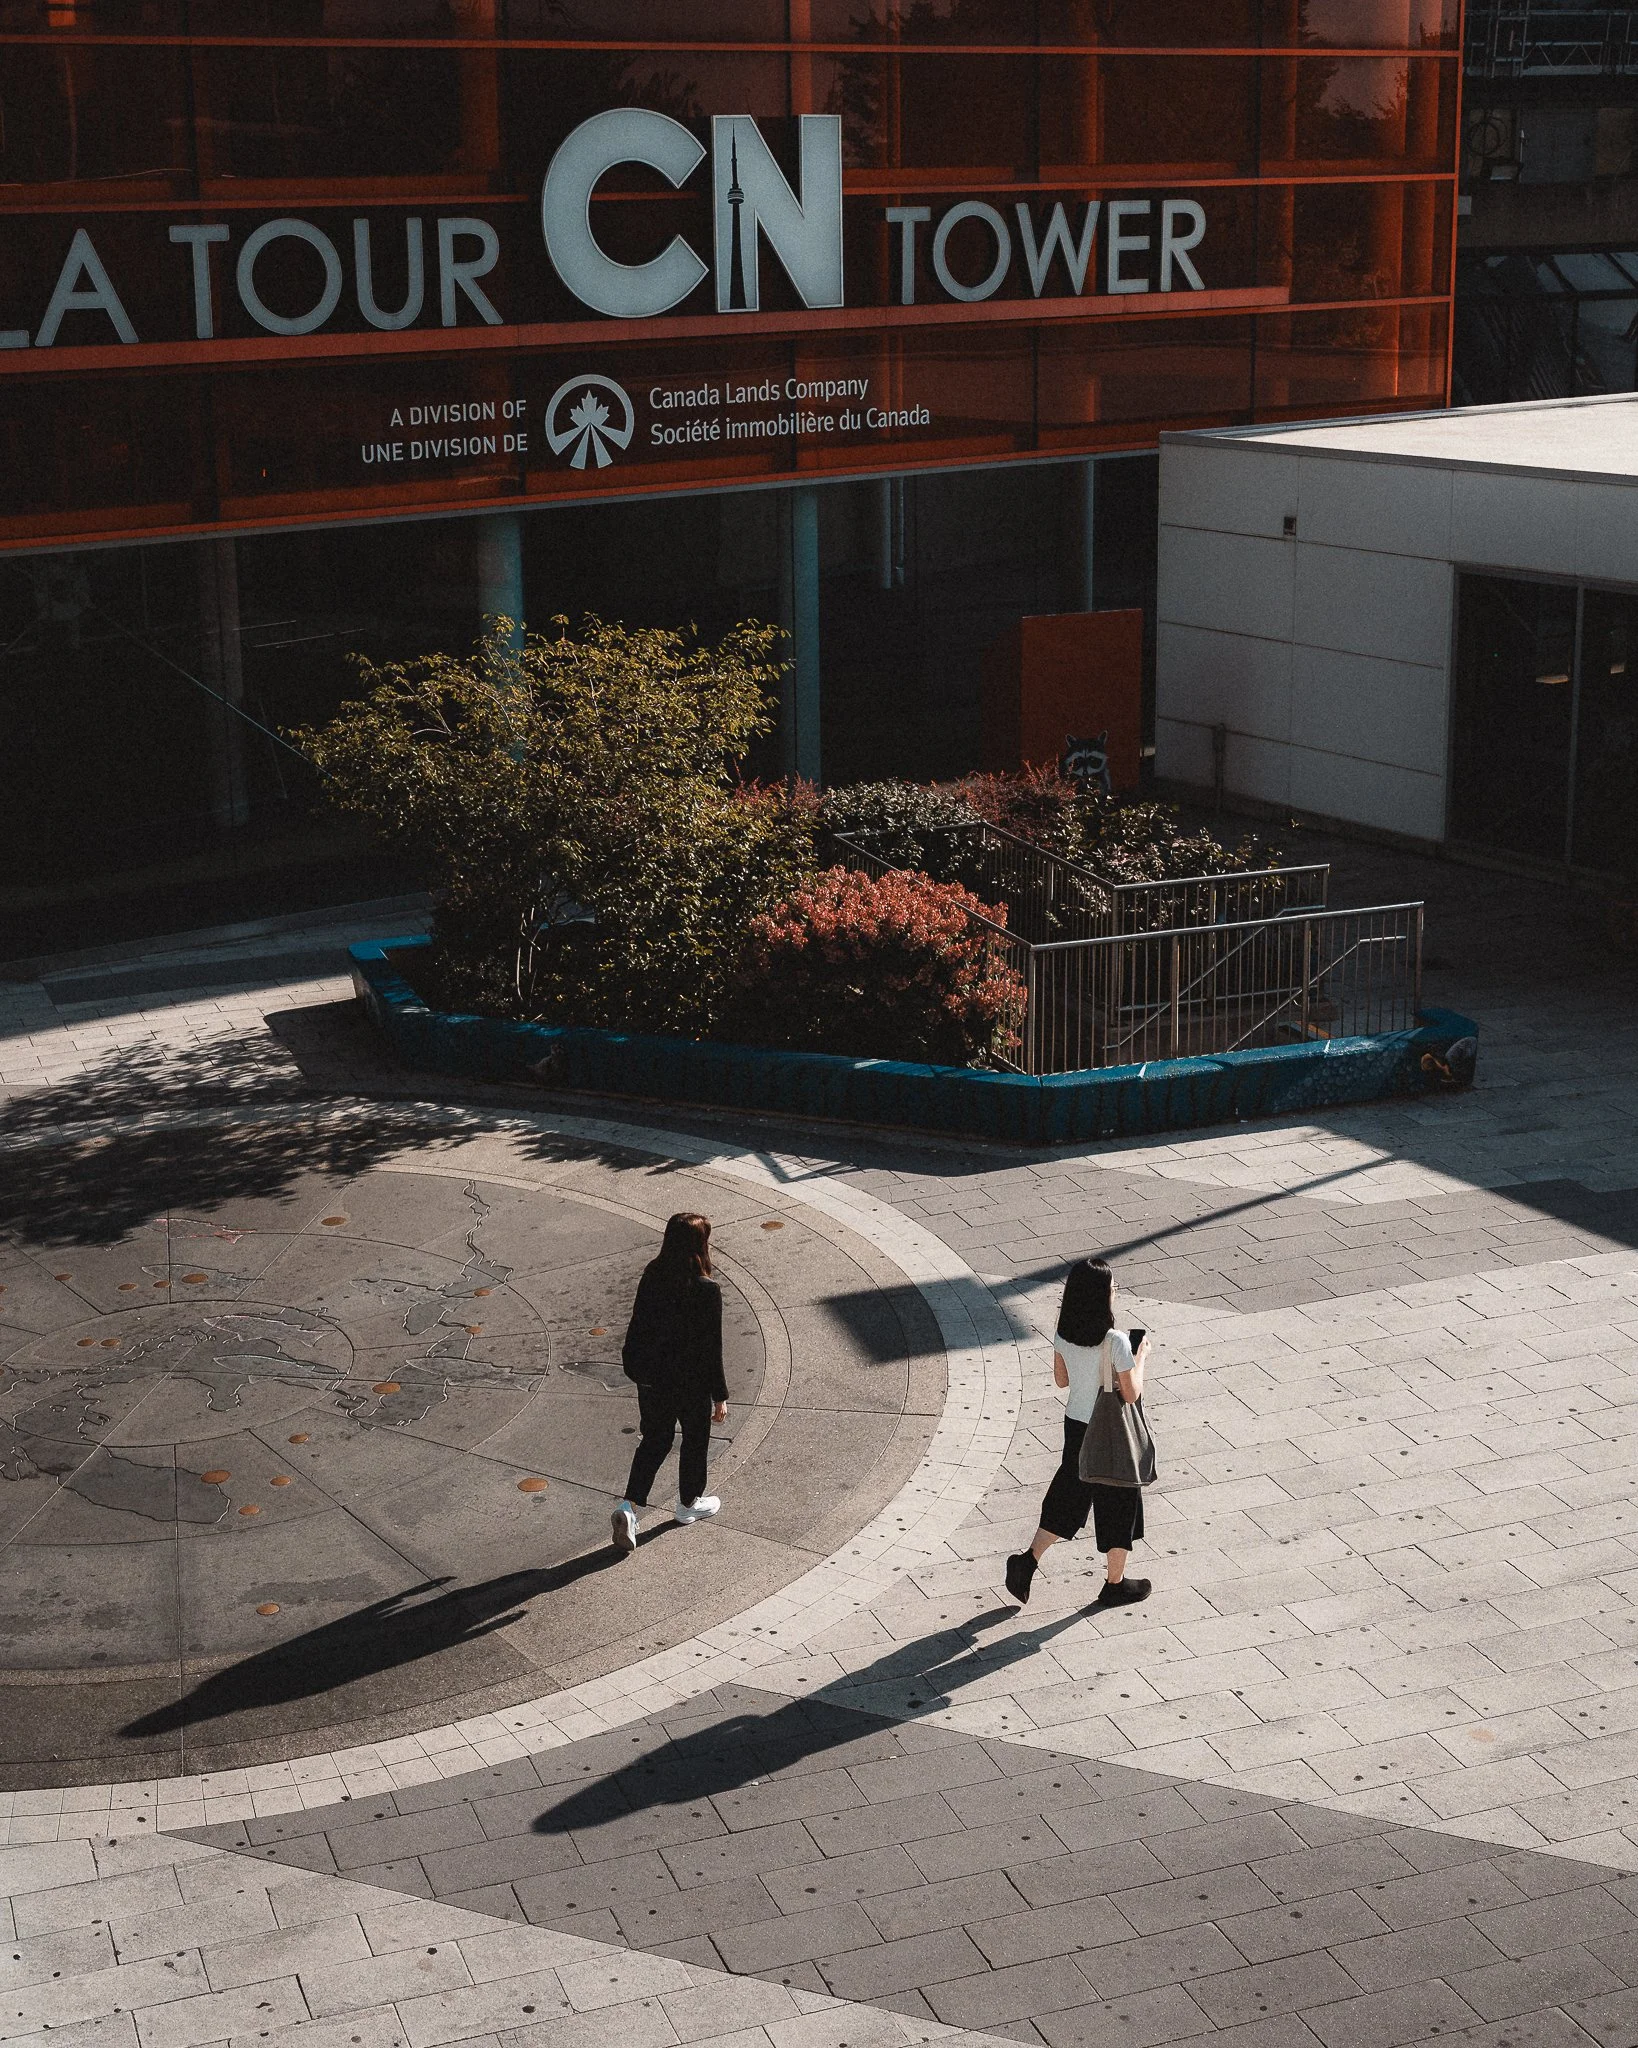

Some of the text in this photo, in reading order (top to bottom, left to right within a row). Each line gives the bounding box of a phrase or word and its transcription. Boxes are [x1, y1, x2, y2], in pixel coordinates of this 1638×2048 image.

[0, 107, 1206, 349] A TOUR CN TOWER
[649, 378, 869, 409] Canada Lands Company
[390, 400, 527, 427] A DIVISION OF
[650, 404, 930, 445] Société immobilière du Canada
[362, 434, 528, 463] UNE DIVISION DE
